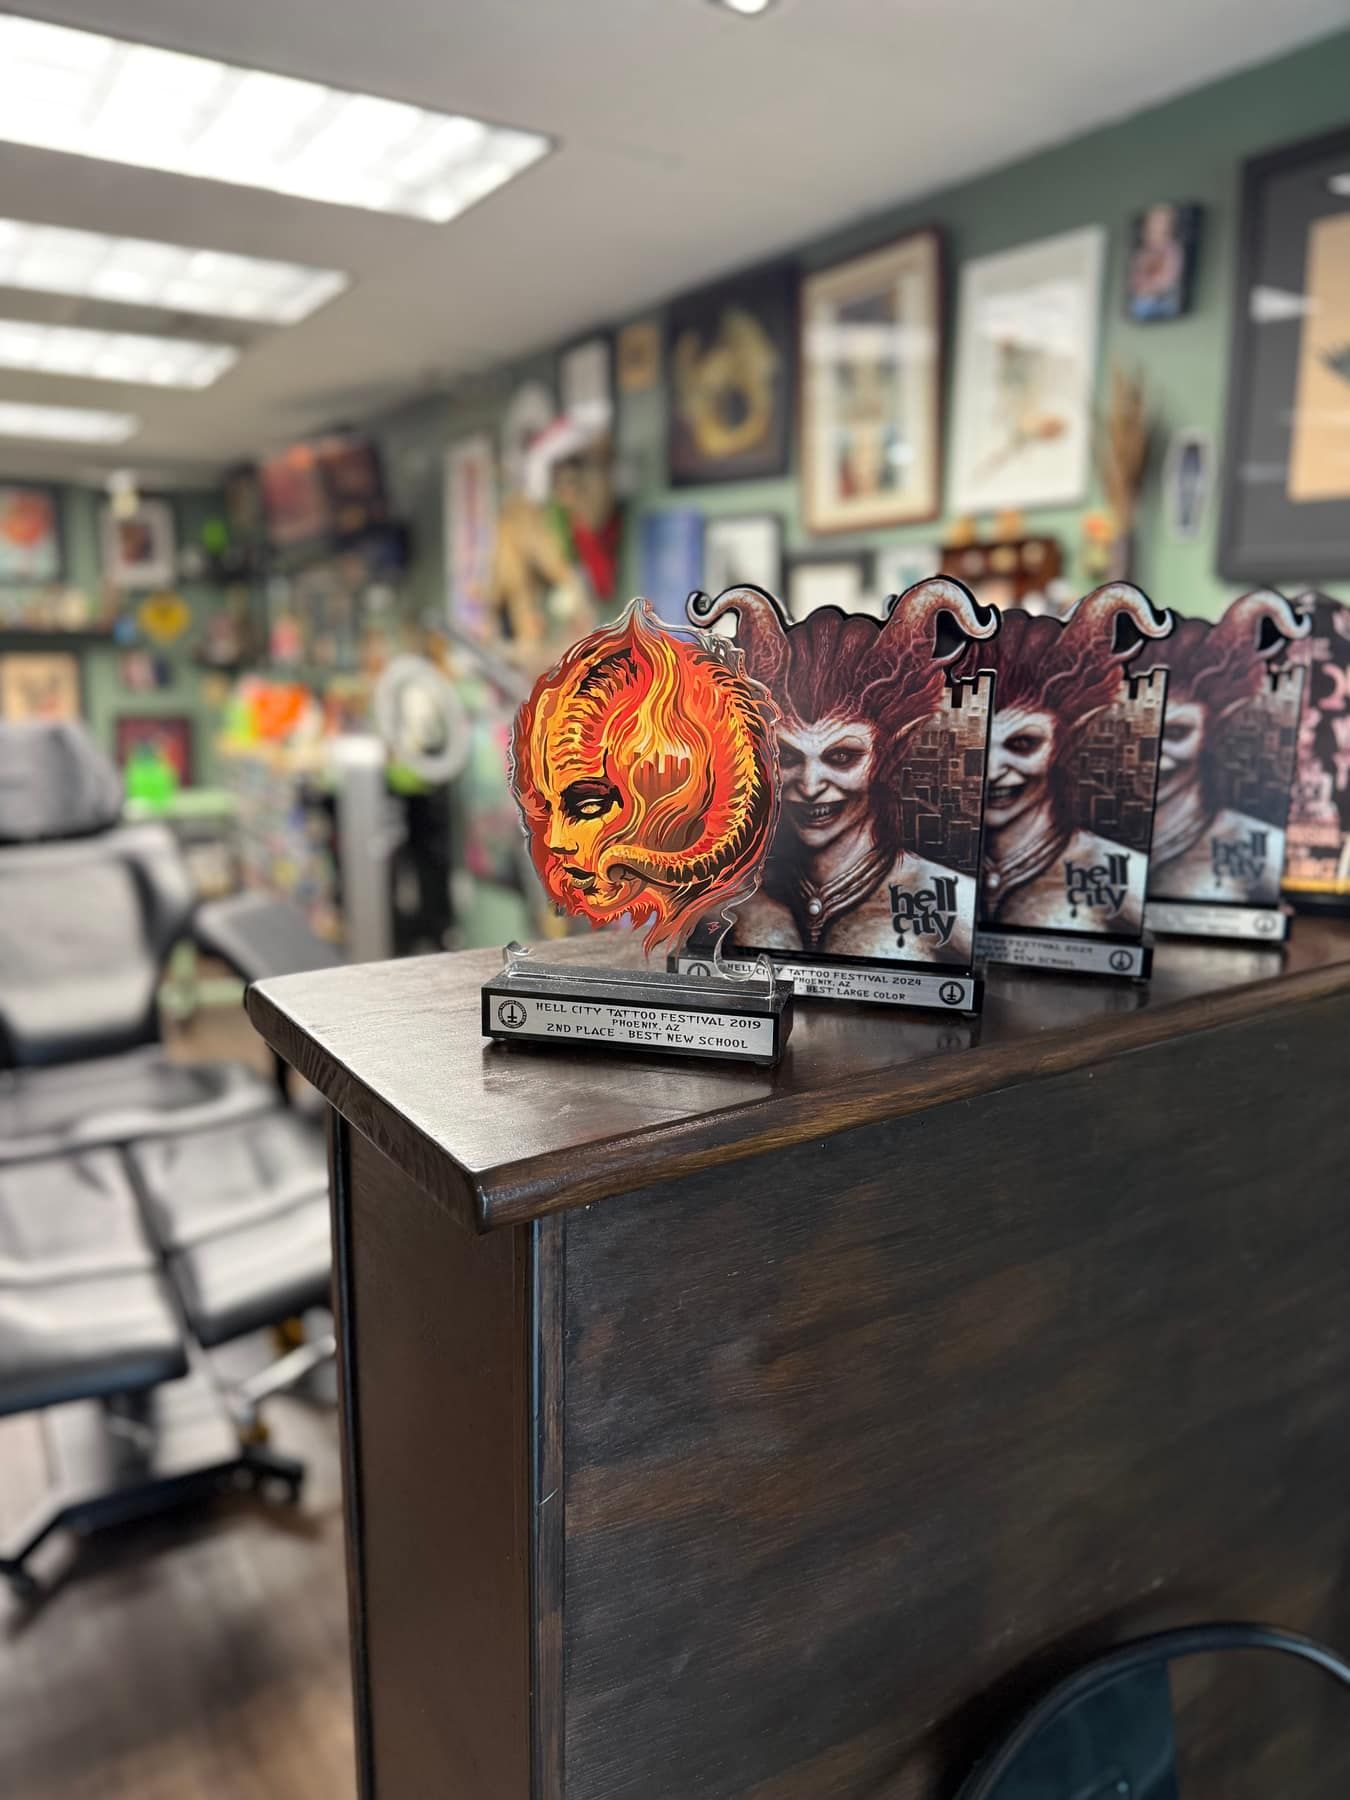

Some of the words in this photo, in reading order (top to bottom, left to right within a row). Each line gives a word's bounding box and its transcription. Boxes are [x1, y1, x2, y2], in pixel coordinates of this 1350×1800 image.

[1064, 852, 1131, 887] hell
[888, 875, 959, 914] hell
[1066, 882, 1128, 919] city
[892, 908, 957, 949] city
[727, 963, 753, 973] HELL
[788, 968, 830, 978] TATTOO
[833, 972, 889, 984] FESTIVAL
[892, 976, 922, 987] 2024
[838, 980, 852, 988] AZ
[806, 985, 834, 994] BEST
[836, 987, 870, 998] LARGE
[873, 991, 906, 1001] COLOR
[535, 1002, 568, 1013] HELL
[572, 1005, 602, 1016] CITY
[606, 1008, 657, 1021] TATTOO
[660, 1012, 725, 1027] FESTIVAL
[730, 1018, 762, 1030] 2019
[665, 1024, 681, 1032] AZ
[546, 1023, 571, 1033] 2ND
[576, 1025, 615, 1037] PLACE
[628, 1029, 662, 1041] BEST
[667, 1033, 694, 1044] NEW
[699, 1036, 749, 1049] SCHOOL
